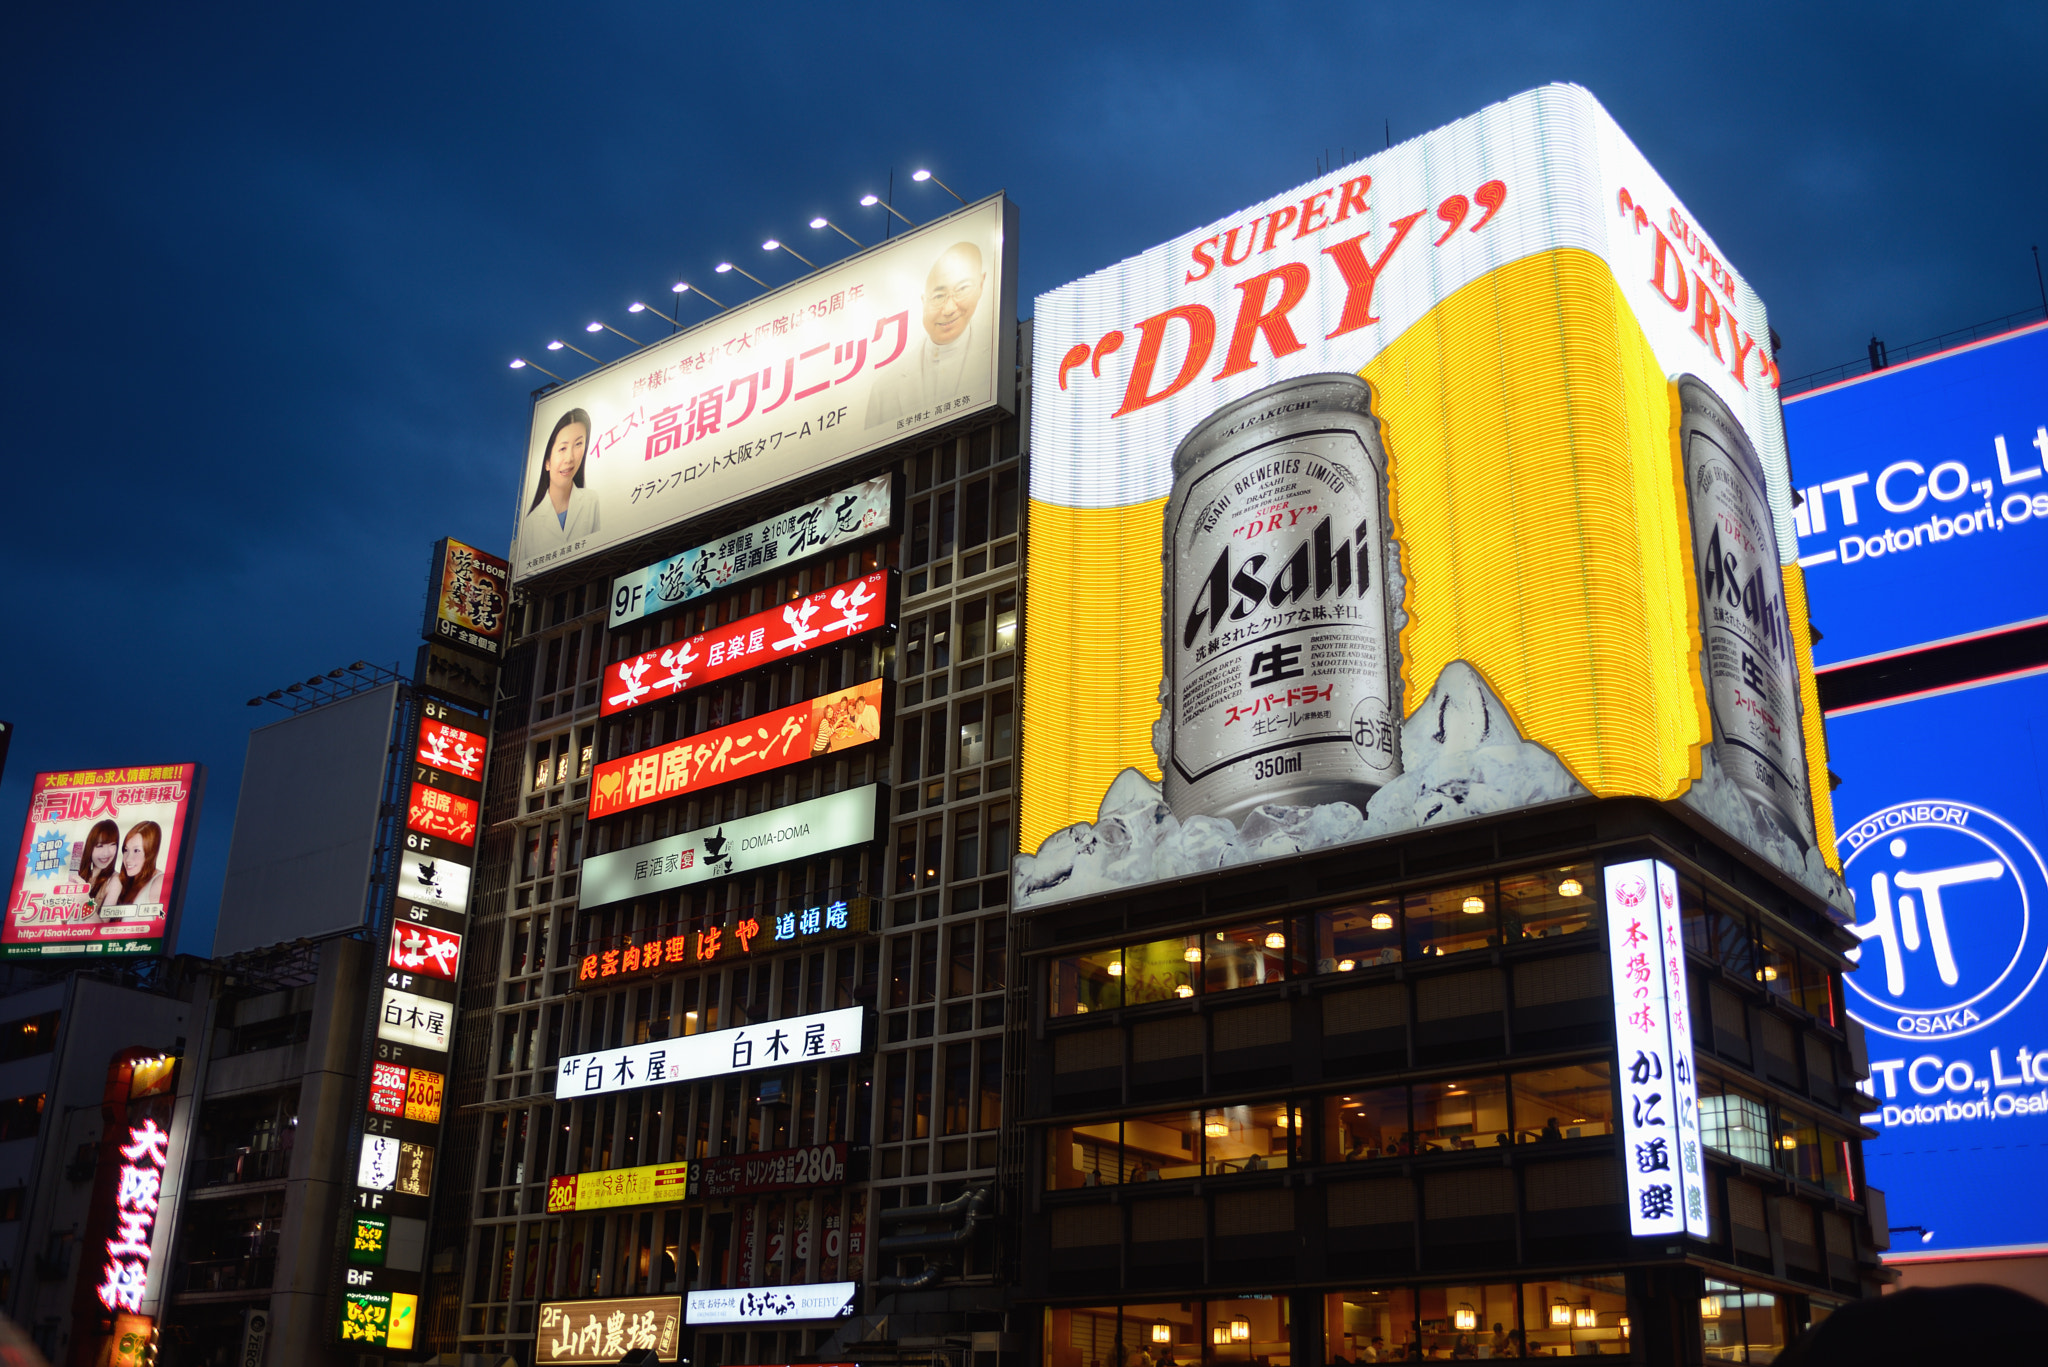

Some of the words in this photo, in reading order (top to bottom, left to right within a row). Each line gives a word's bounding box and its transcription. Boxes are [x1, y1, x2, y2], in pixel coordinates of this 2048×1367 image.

[1184, 174, 1372, 285] SUPER
[1668, 206, 1736, 307] SUPER
[644, 310, 909, 462] 高須クリニック
[816, 405, 848, 432] 12F
[1203, 494, 1232, 534] ASAHI
[1234, 458, 1301, 496] BREWERIES
[1305, 461, 1345, 494] LIMITED
[1246, 488, 1273, 505] DRAFT
[1274, 483, 1298, 494] BEER
[1258, 477, 1284, 491] ASAHI
[1255, 501, 1290, 518] SUPER
[718, 531, 754, 561] 全室個室
[761, 514, 797, 543] 全160席
[732, 540, 779, 575] 居酒屋
[1184, 514, 1370, 650] Asahi
[1704, 521, 1786, 663] Asahi
[615, 583, 643, 617] 9F
[440, 618, 458, 637] 9F
[771, 581, 877, 652] 笑笑
[706, 627, 766, 668] 居楽屋
[608, 641, 700, 707] 笑笑
[1249, 643, 1305, 689] 生
[1223, 683, 1334, 727] スーパードライ
[439, 725, 469, 743] 居楽屋
[626, 714, 808, 804] 相席ダイニング
[1254, 752, 1302, 781] 350ml
[41, 788, 119, 822] 高収入
[115, 785, 187, 806] お仕事探し
[421, 788, 453, 813] 相席
[408, 804, 476, 841] ダイニング
[1846, 805, 1969, 849] DOTONBORI
[740, 823, 811, 852] DOMA-DOMA
[633, 853, 679, 882] 居酒家
[409, 905, 430, 921] 5F
[17, 927, 96, 940] http://15navi.com/
[393, 927, 459, 976] はや
[579, 935, 686, 981] 民芸肉料理
[1621, 917, 1656, 1034] 本場の味
[384, 998, 445, 1036] 白木屋
[1896, 1008, 1980, 1033] OSAKA
[731, 1023, 827, 1069] 白木屋
[372, 1070, 406, 1091] 280円
[375, 1063, 406, 1076] ドリンク全品
[412, 1070, 440, 1085] 全品
[562, 1058, 581, 1077] 4F
[584, 1050, 667, 1092] 白木屋
[407, 1081, 442, 1108] 280円
[402, 1142, 414, 1153] 2F
[359, 1192, 384, 1209] 1F
[354, 1237, 382, 1252] ドンキー
[357, 1225, 383, 1240] びっくり
[346, 1268, 374, 1286] B1F
[346, 1298, 387, 1324] びっくり
[542, 1307, 562, 1328] 2F
[690, 1299, 706, 1310] 大阪
[706, 1297, 736, 1310] お好み焼
[842, 1304, 855, 1316] 2F
[341, 1320, 387, 1343] ドンキー
[551, 1310, 658, 1359] 山内農場
